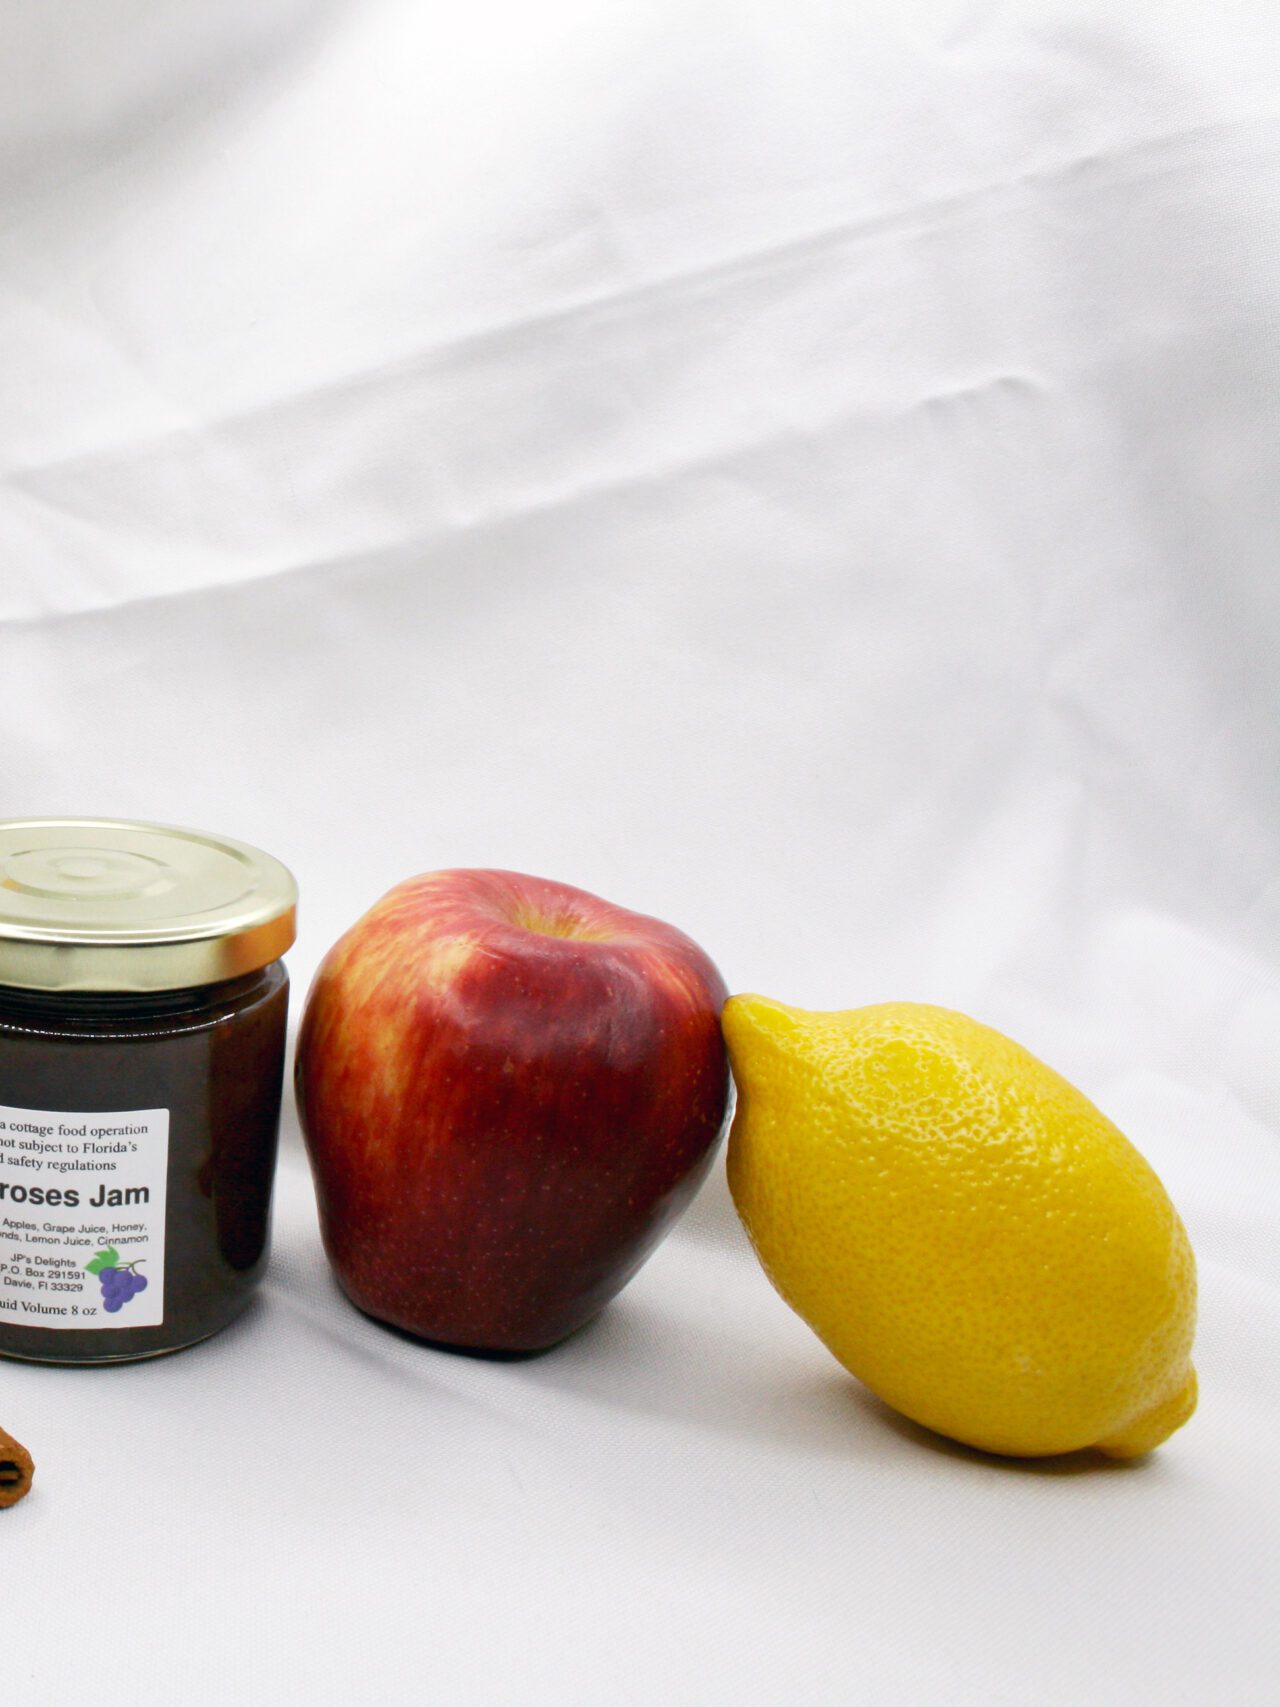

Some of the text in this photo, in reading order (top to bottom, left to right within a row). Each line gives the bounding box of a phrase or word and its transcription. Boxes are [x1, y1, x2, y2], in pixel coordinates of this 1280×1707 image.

[0, 1121, 6, 1130] a
[9, 1122, 54, 1138] cottage
[58, 1124, 87, 1136] food
[90, 1123, 148, 1139] operation
[18, 1140, 63, 1154] subject
[67, 1143, 79, 1153] to
[83, 1141, 138, 1154] Florida's
[7, 1155, 43, 1171] safety
[47, 1159, 117, 1173] regulations
[89, 1184, 150, 1208] Jam
[2, 1217, 40, 1232] Apples,
[43, 1223, 75, 1234] Grape
[78, 1224, 109, 1234] Juice,
[112, 1223, 147, 1233] Honey,
[25, 1233, 60, 1245] Lemon
[63, 1236, 94, 1246] Juice,
[97, 1235, 149, 1246] Cinnamon
[10, 1253, 77, 1269] JP's Delights
[0, 1263, 85, 1280] P.O. Box 291591
[3, 1276, 35, 1290] Davie,
[50, 1282, 83, 1292] 33329
[21, 1300, 67, 1316] Volume
[71, 1305, 79, 1316] 8
[82, 1307, 97, 1316] oz
